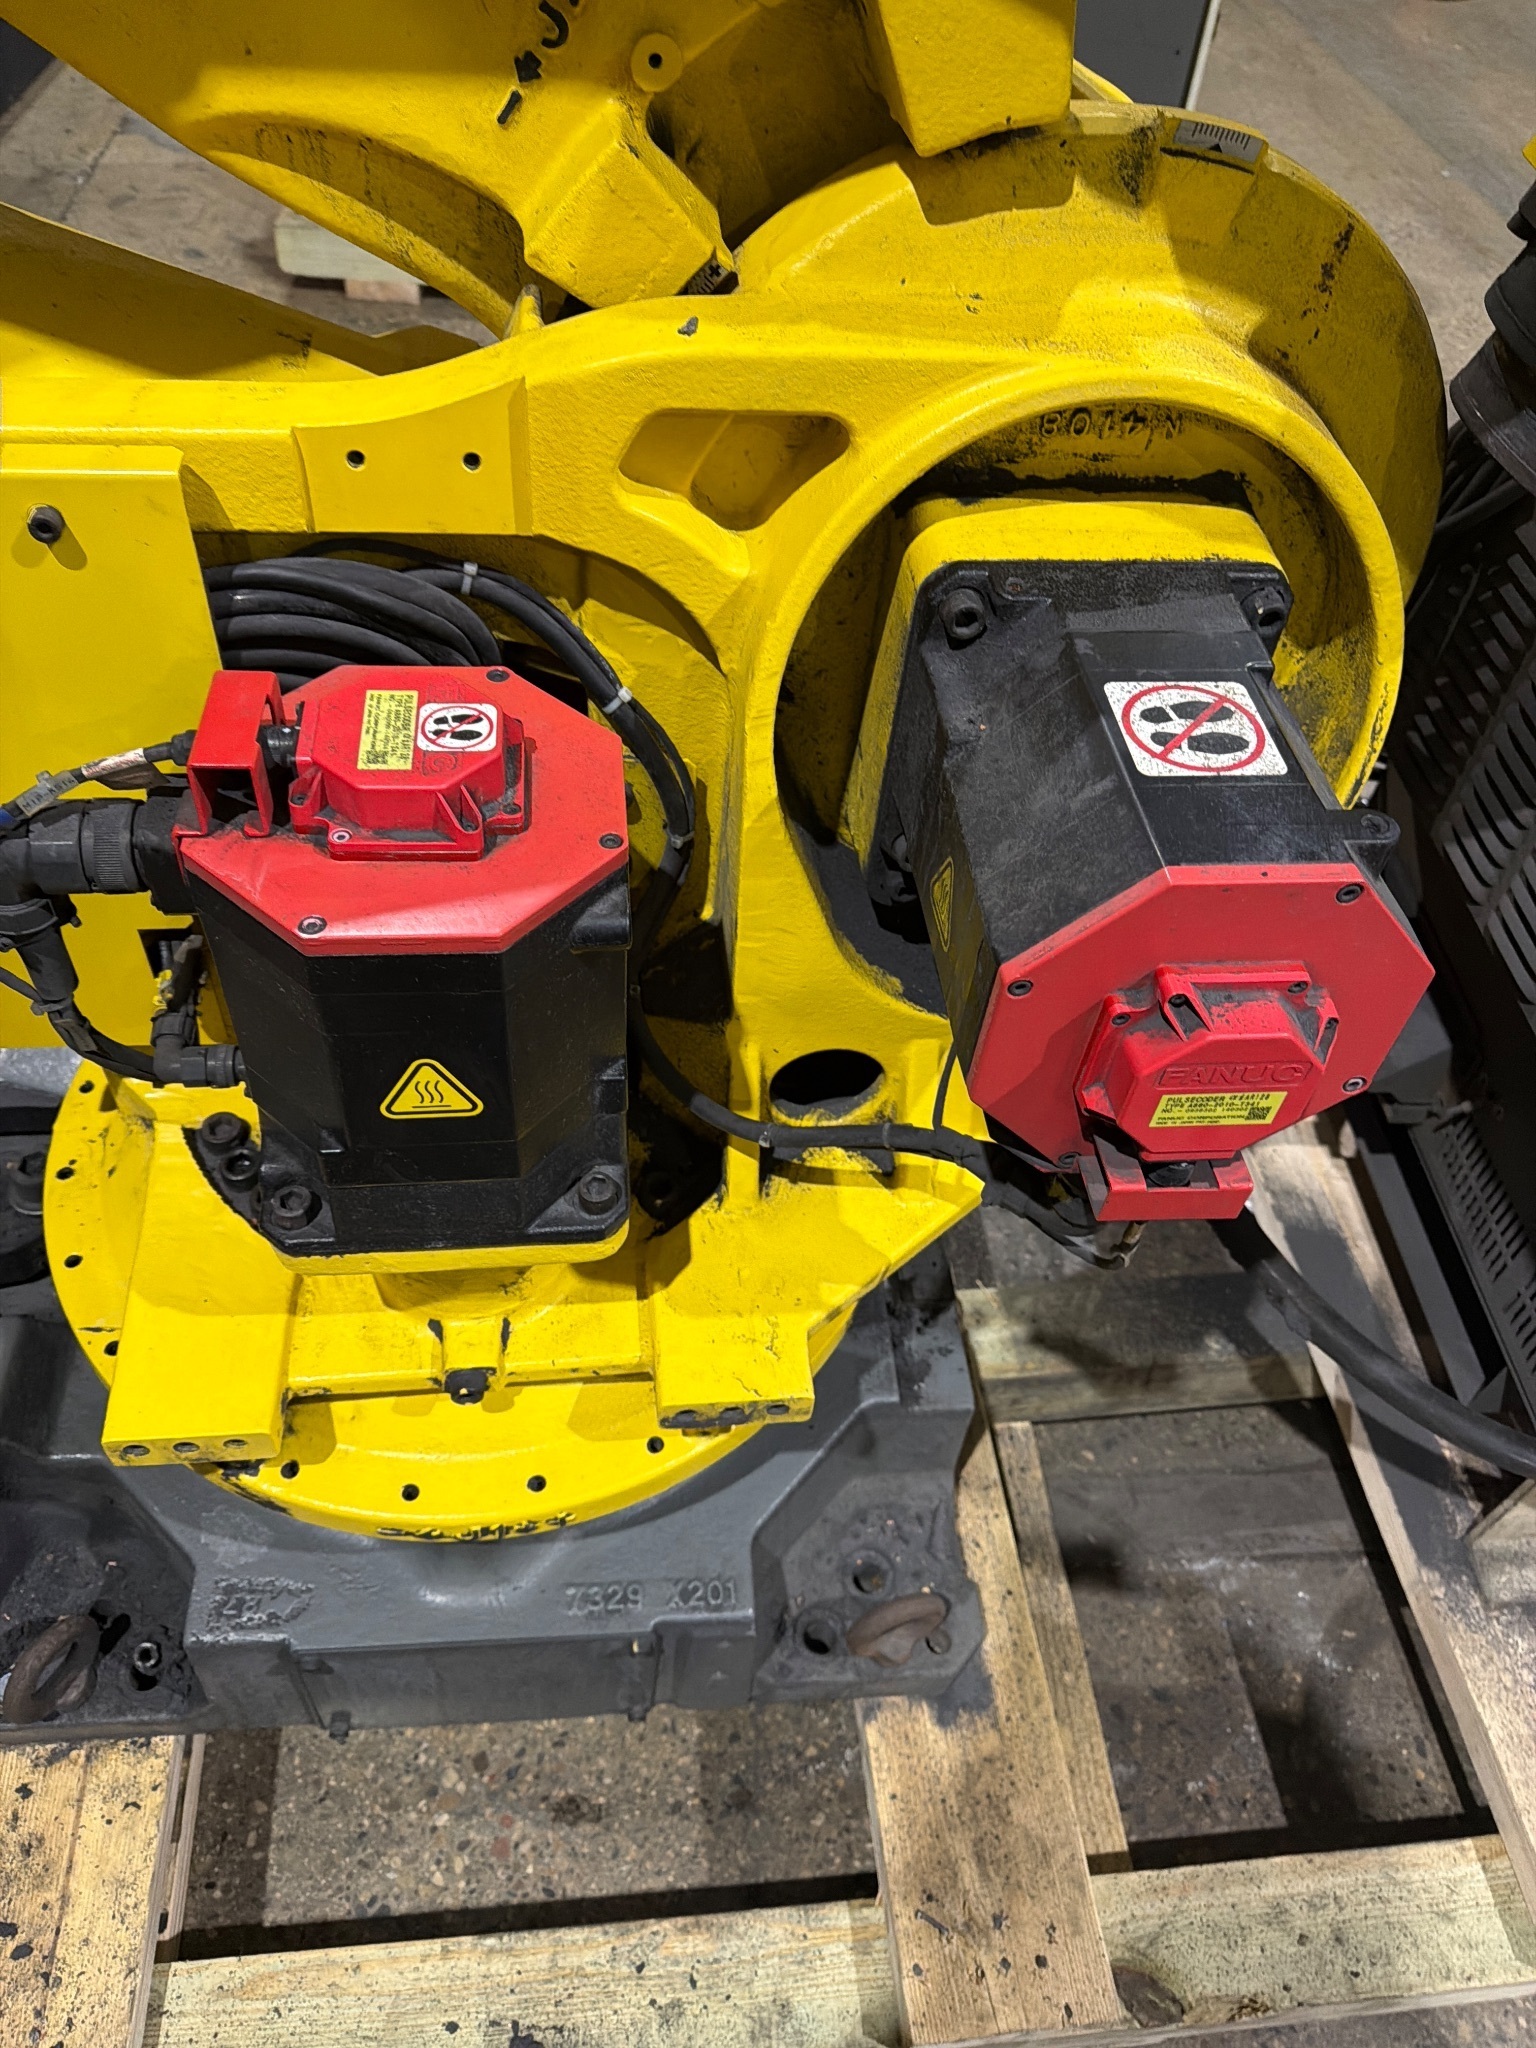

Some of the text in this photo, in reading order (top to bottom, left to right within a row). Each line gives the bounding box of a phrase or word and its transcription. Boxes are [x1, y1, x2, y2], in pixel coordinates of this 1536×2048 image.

[1157, 1063, 1304, 1085] FANUC
[1166, 1096, 1226, 1104] PULSECODER
[565, 1578, 737, 1616] 7329 X201
